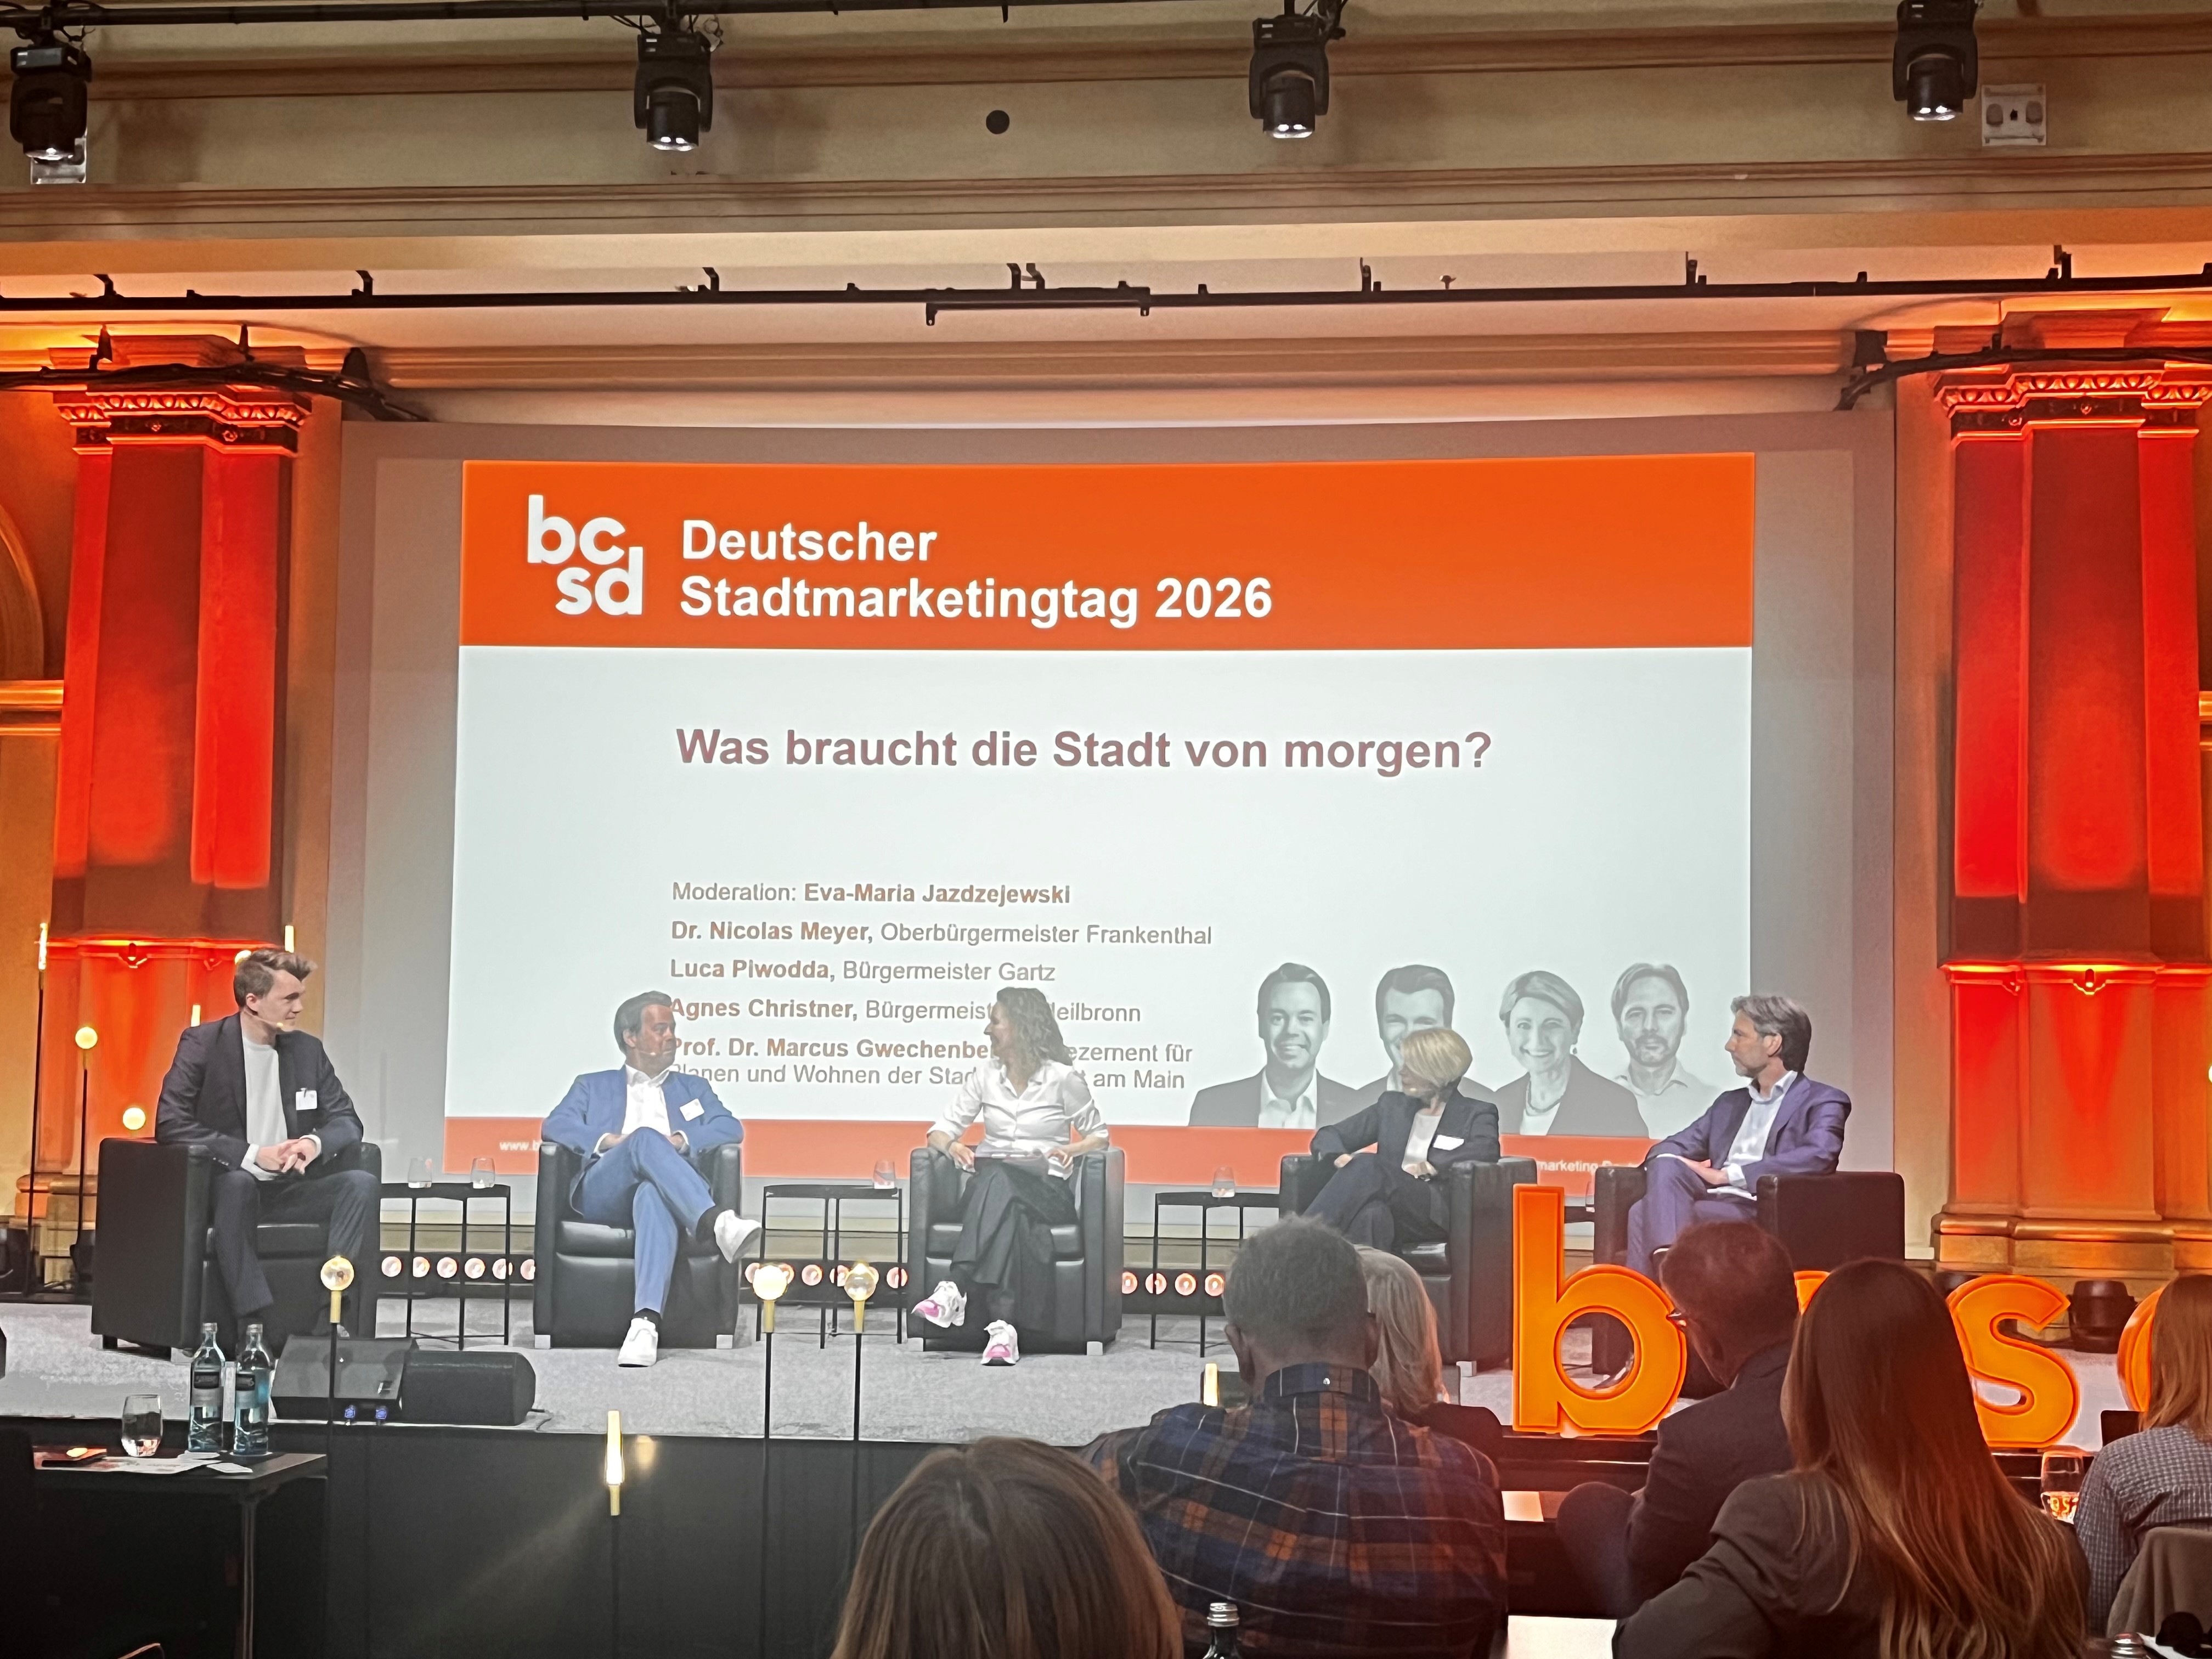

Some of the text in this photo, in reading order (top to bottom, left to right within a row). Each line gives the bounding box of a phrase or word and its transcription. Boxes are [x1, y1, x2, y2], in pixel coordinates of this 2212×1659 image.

[682, 520, 938, 562] Deutscher
[680, 575, 1272, 629] Stadtmarketingtag 2026
[676, 728, 1491, 777] Was braucht die Stadt von morgen?
[673, 882, 1070, 907] Moderation: Eva-Maria Jazdzejewski
[672, 921, 1211, 946] Dr. Nicolas Meyer, Oberbürgermeister Frankenthal
[671, 959, 1056, 984] Luca Piwodda, Bürgermeister Gartz
[671, 998, 740, 1021] Agnes
[748, 998, 857, 1022] Christner,
[867, 1000, 992, 1023] Bürgermeist
[729, 1038, 758, 1056] Dr.
[767, 1038, 848, 1057] Marcus
[1072, 1045, 1158, 1062] ezernent
[1166, 1043, 1193, 1062] für
[748, 1064, 786, 1082] und
[793, 1064, 880, 1084] Wohnen
[888, 1066, 922, 1084] der
[1093, 1073, 1126, 1087] am
[1134, 1069, 1184, 1089] Main
